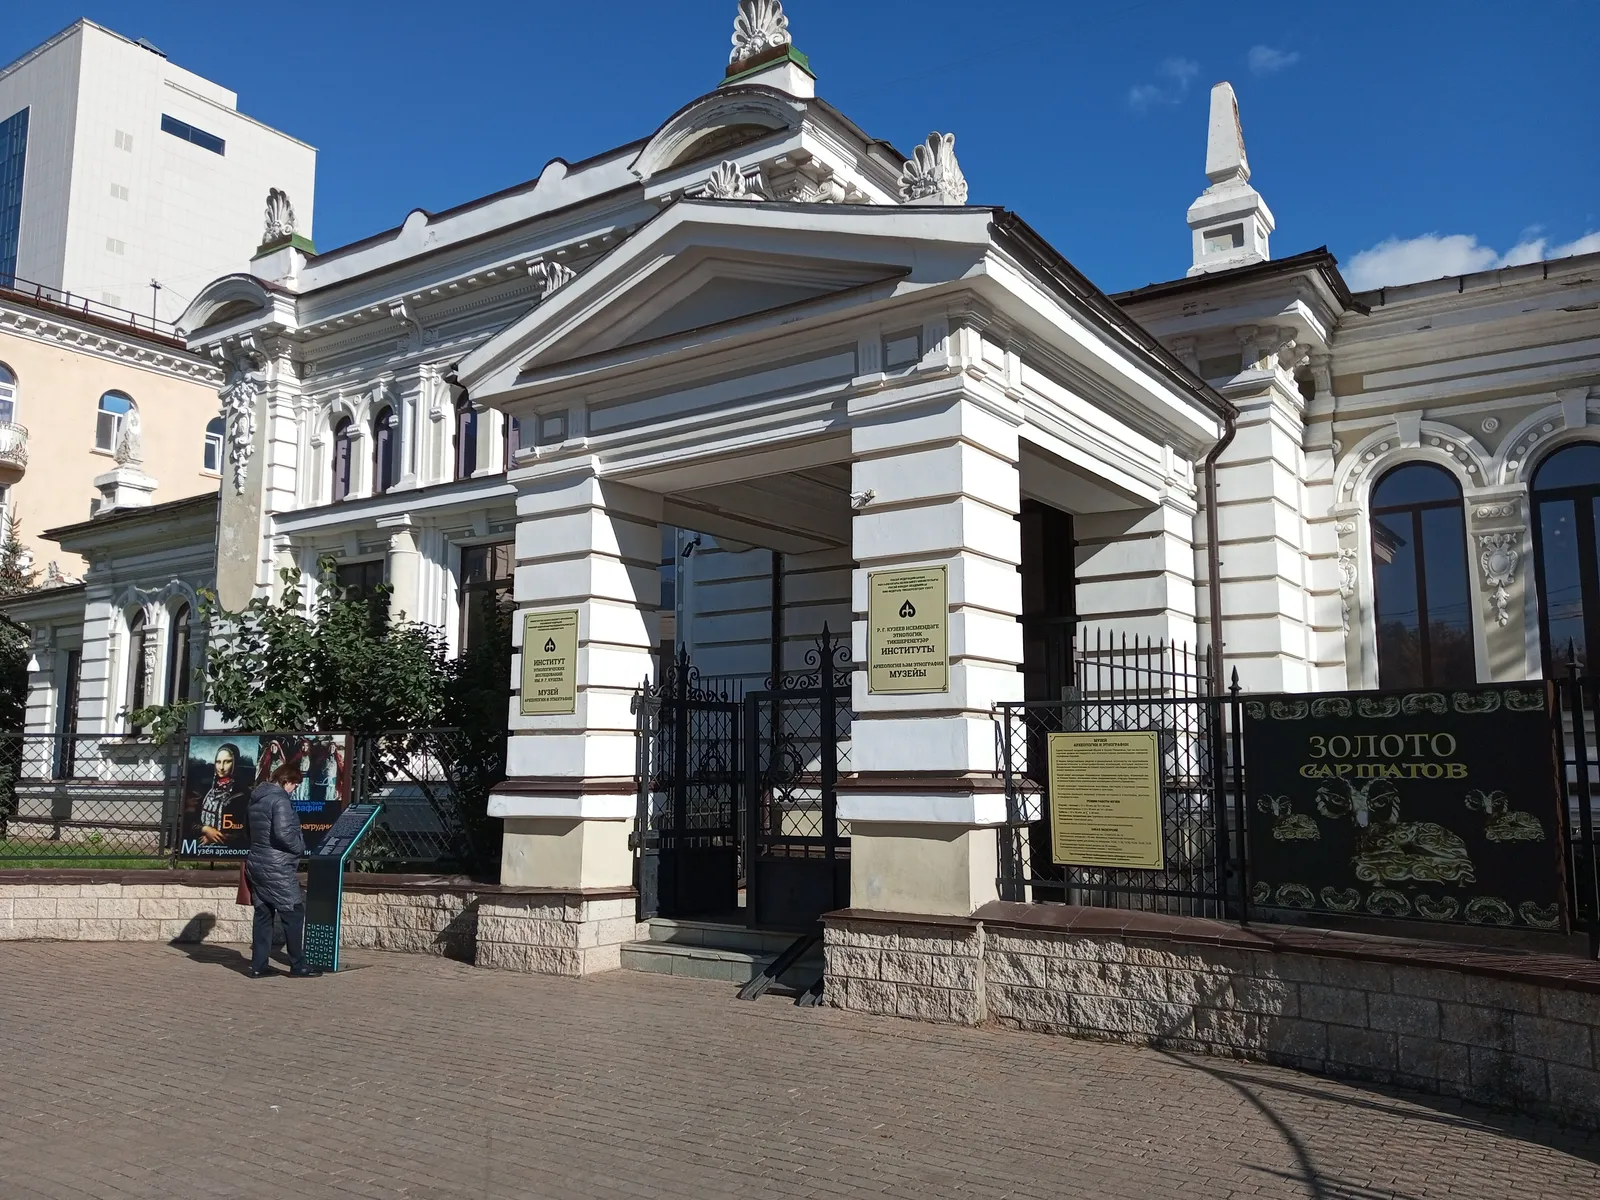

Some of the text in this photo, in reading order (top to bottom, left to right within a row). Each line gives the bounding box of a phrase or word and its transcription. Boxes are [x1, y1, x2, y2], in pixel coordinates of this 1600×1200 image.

[881, 645, 935, 655] ИНСТИТУТЫ
[534, 658, 565, 666] ИНСТИТУТ
[889, 668, 926, 678] МУЗЕЙЫ
[538, 688, 558, 696] МУЗЕЙ
[1309, 733, 1457, 758] ЗОЛОТО
[1300, 763, 1468, 779] САРМАТОВ
[181, 839, 213, 856] Музея
